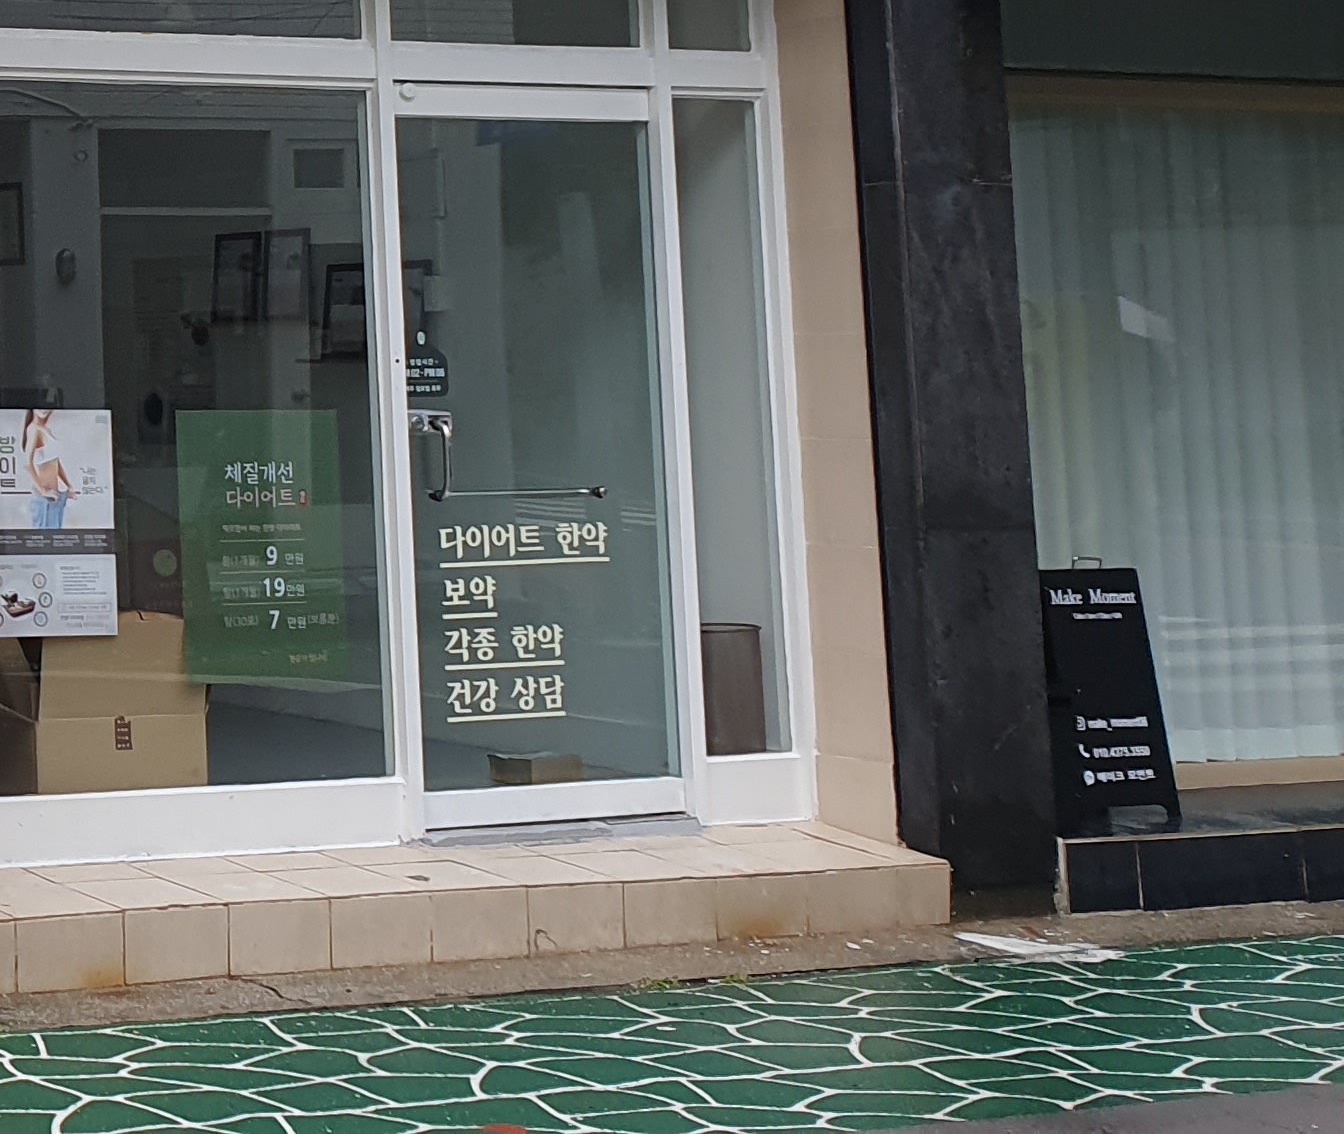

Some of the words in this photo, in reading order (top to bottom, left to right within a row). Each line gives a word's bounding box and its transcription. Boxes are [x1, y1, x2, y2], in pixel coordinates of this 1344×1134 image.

[224, 461, 294, 484] 체질개선
[226, 486, 296, 509] 다이어트
[438, 523, 545, 559] 다이어트
[555, 521, 609, 555] 한약
[265, 545, 278, 566] 9
[441, 575, 496, 609] 보약
[1049, 589, 1084, 605] Make
[1088, 588, 1137, 604] Moment
[268, 609, 280, 630] 7
[444, 627, 499, 662] 각종
[510, 623, 564, 658] 한약
[446, 677, 499, 713] 건강
[510, 674, 565, 710] 상담
